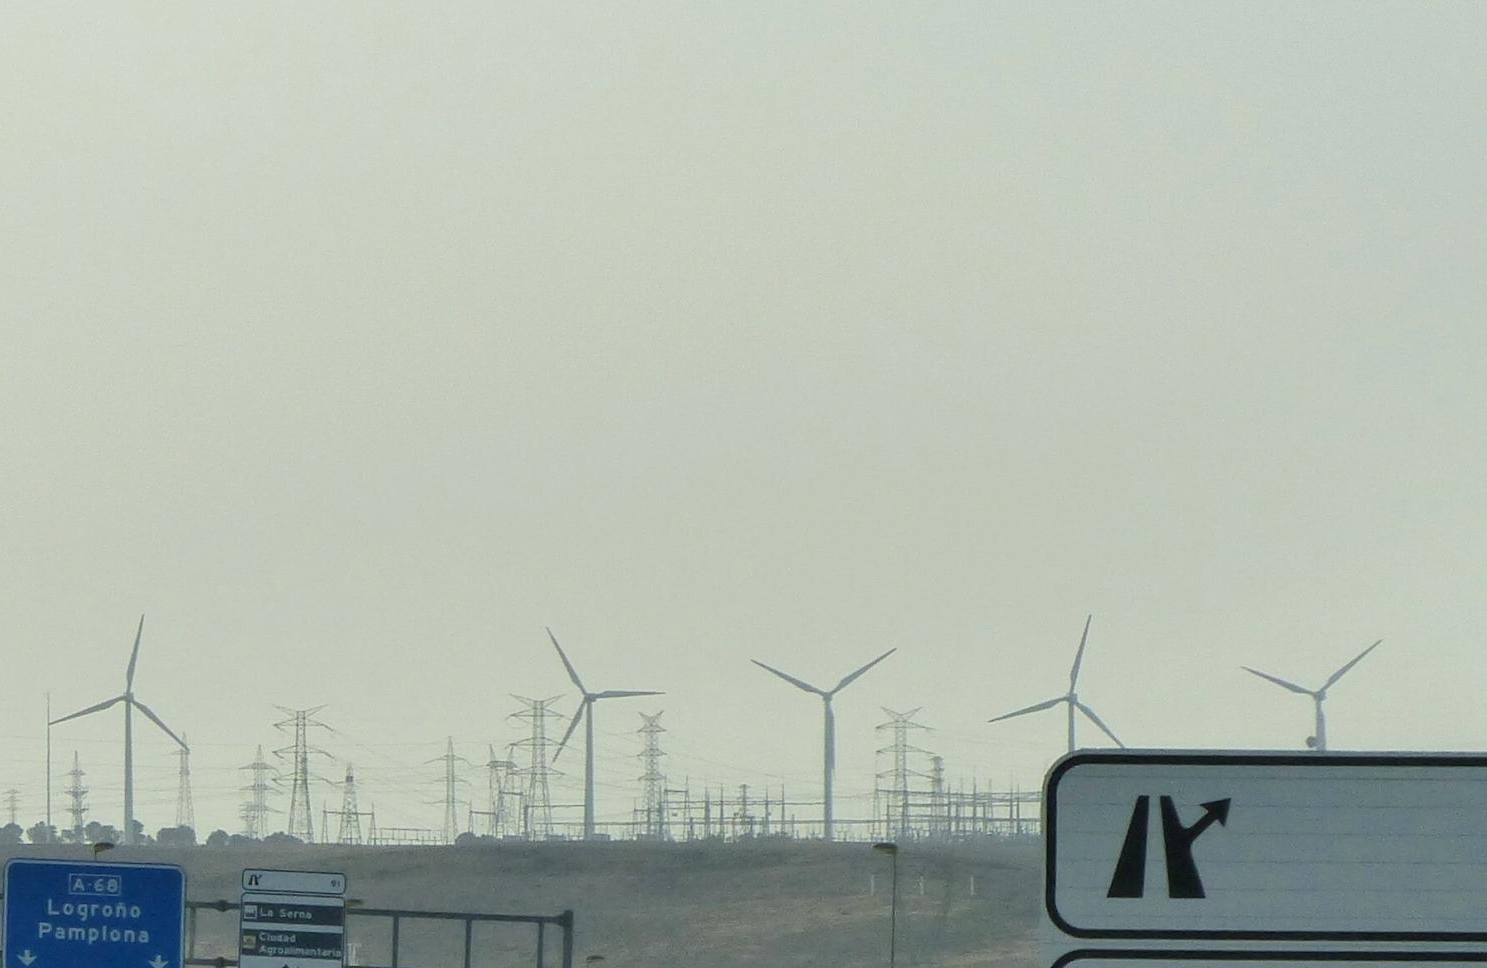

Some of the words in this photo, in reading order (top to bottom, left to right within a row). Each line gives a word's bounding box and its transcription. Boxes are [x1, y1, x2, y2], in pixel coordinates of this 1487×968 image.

[72, 878, 119, 893] A-68
[47, 898, 142, 921] Logroño
[260, 907, 274, 918] La
[279, 908, 313, 920] Serna
[37, 921, 150, 944] Pamplona
[258, 931, 297, 943] Ciudad
